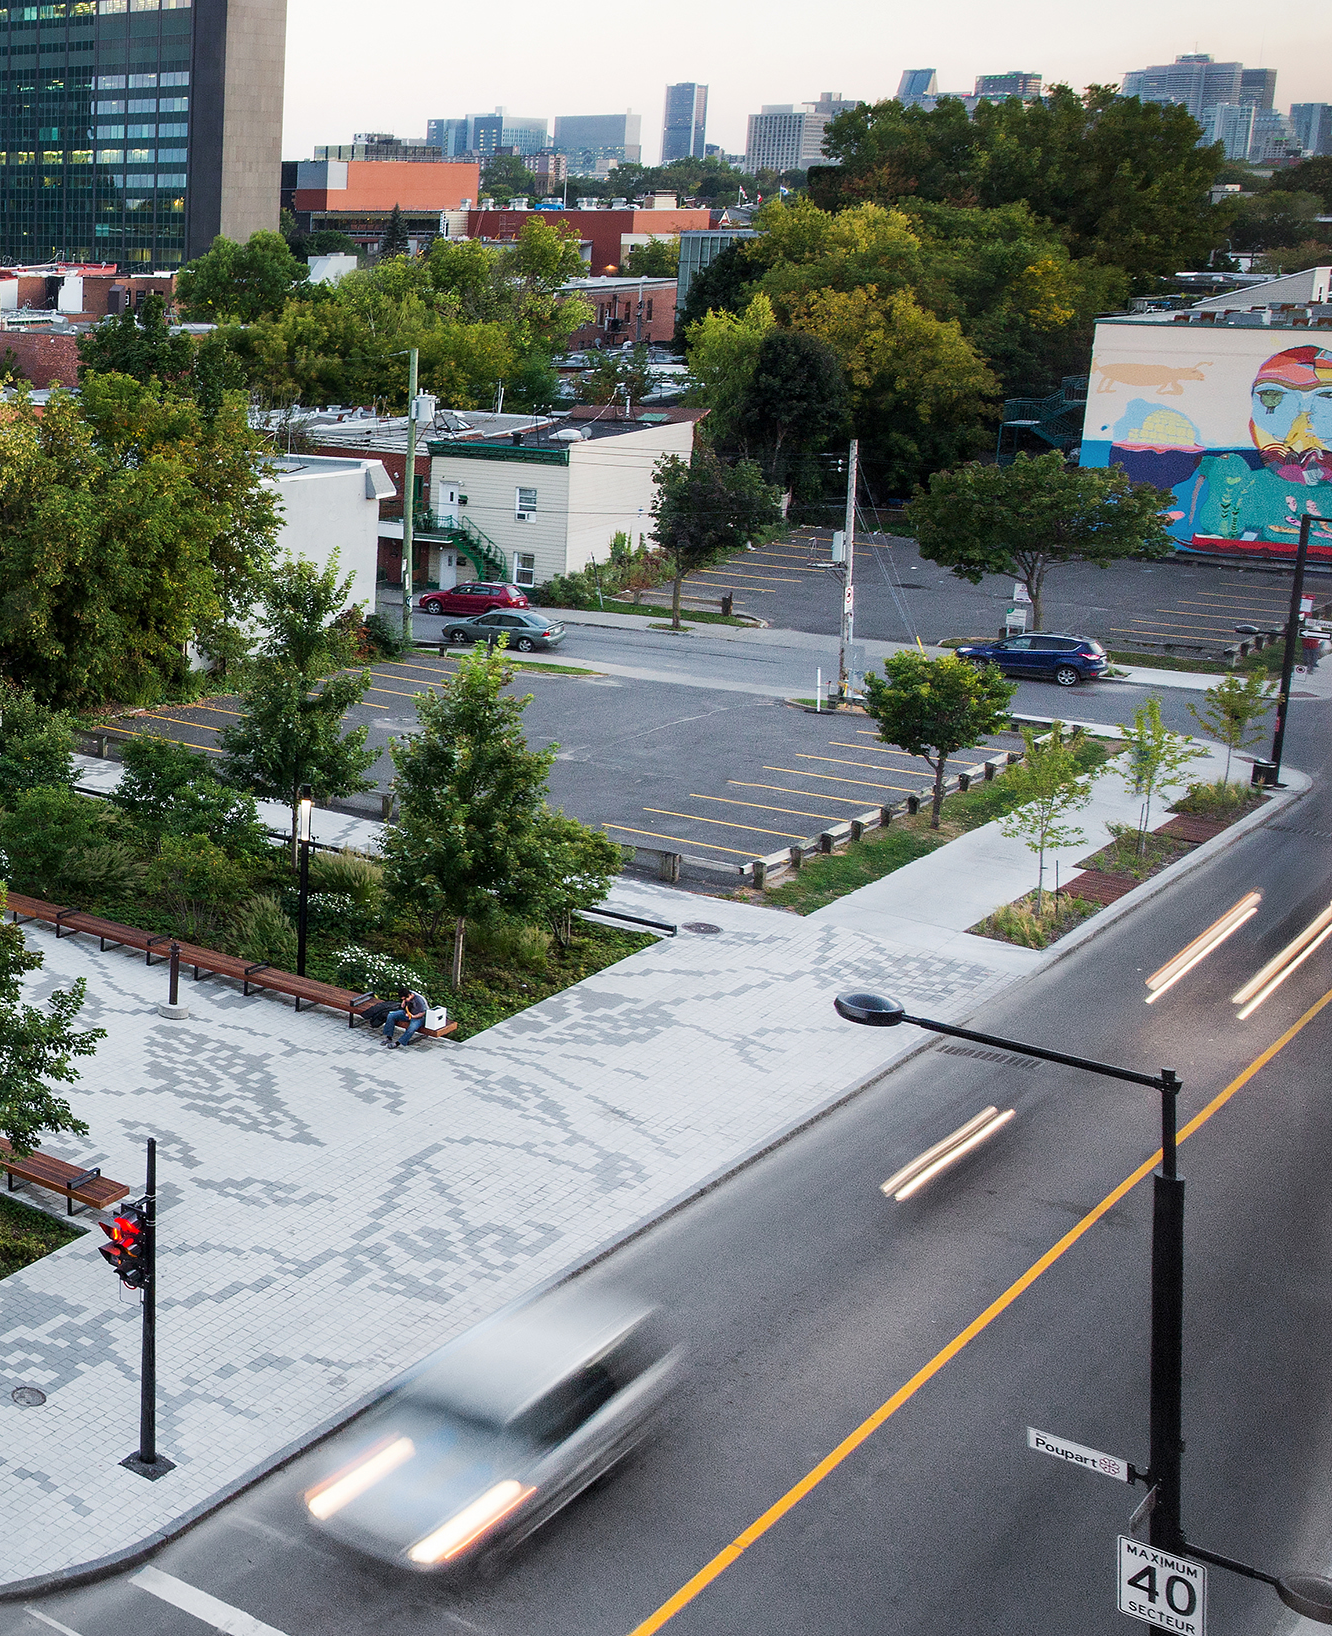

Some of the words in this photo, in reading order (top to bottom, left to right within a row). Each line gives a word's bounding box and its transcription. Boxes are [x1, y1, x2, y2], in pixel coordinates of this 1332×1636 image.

[1035, 1437, 1098, 1468] Poupart
[1126, 1543, 1198, 1579] MAXIMUM
[1127, 1565, 1197, 1617] 40
[1128, 1600, 1196, 1635] SECTEUR
